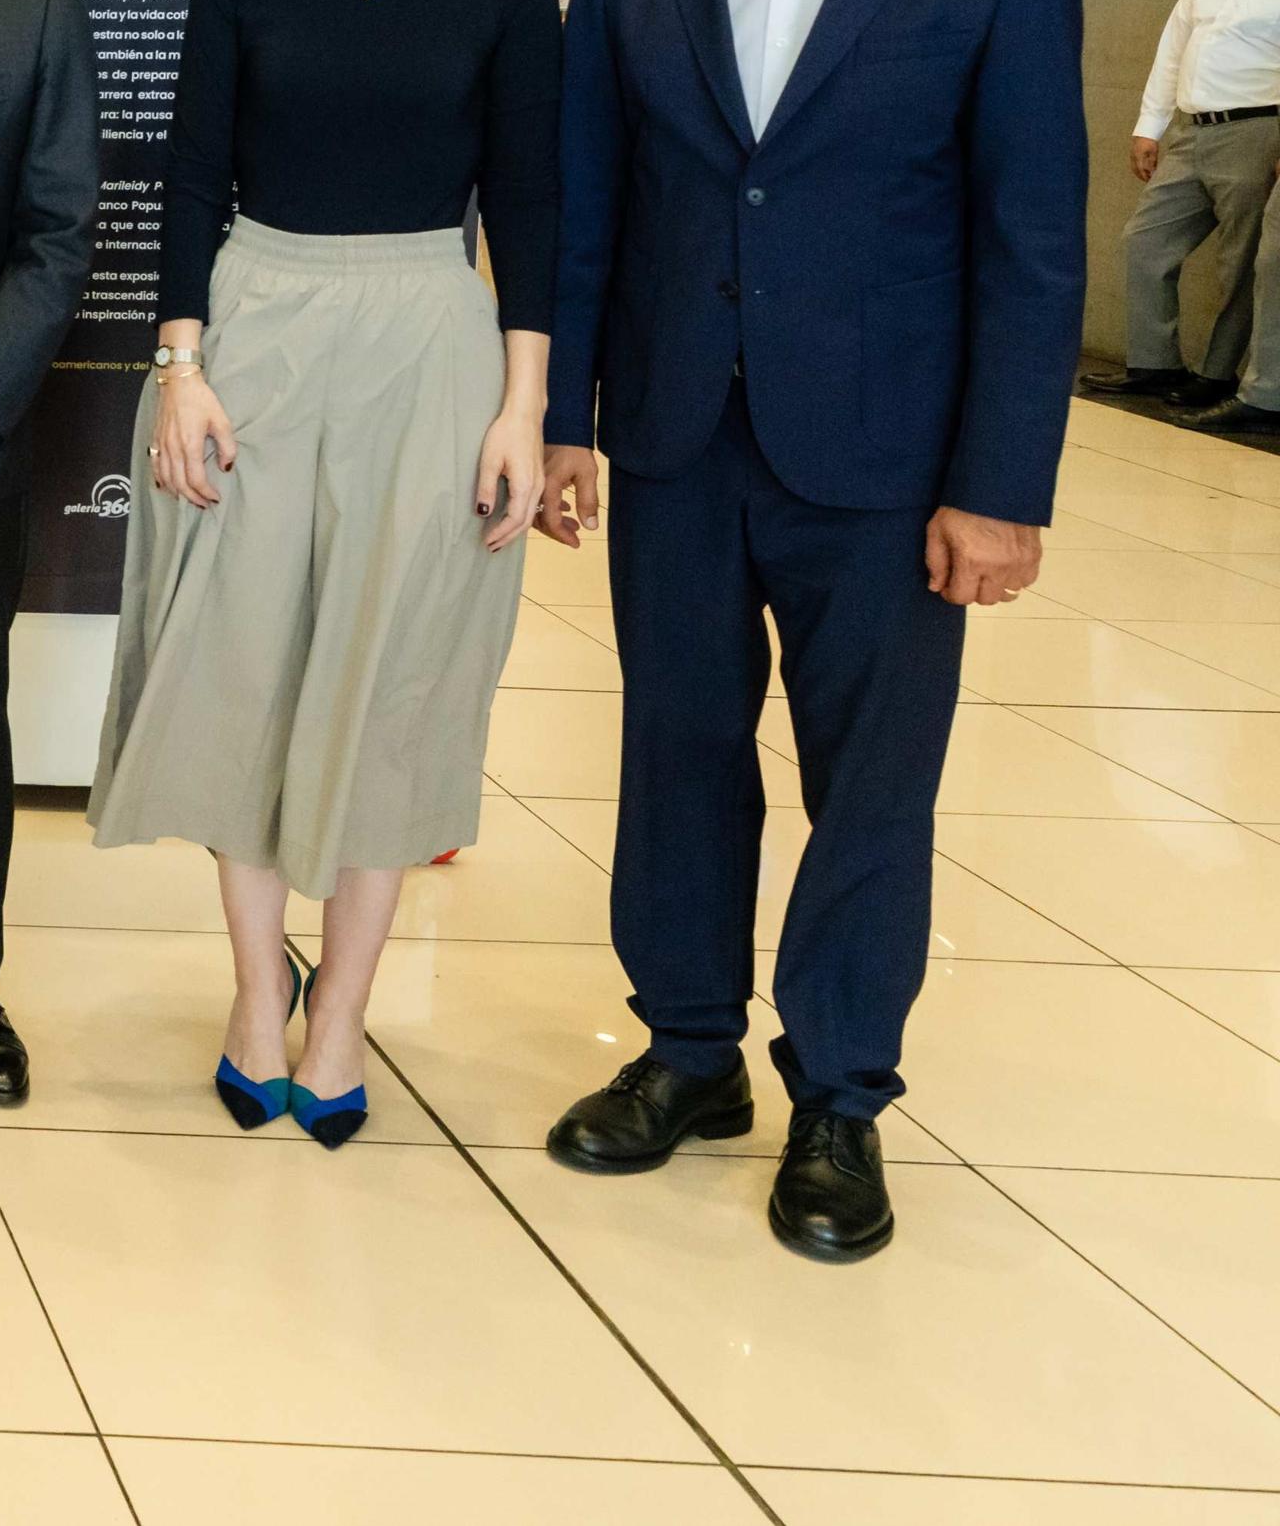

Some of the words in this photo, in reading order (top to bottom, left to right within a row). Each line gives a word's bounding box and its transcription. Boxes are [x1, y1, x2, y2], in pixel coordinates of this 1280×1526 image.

[89, 10, 117, 20] loria
[119, 12, 126, 22] y
[127, 10, 138, 20] la
[140, 10, 165, 20] vida
[124, 32, 140, 40] no
[141, 30, 165, 40] solo
[167, 32, 175, 40] a
[96, 50, 143, 60] ambién
[145, 52, 153, 60] a
[155, 50, 166, 60] la
[111, 69, 128, 80] de
[138, 90, 175, 100] extrao
[122, 109, 133, 120] la
[136, 112, 173, 122] pausa
[102, 129, 143, 140] iliencia
[146, 132, 154, 142] y
[156, 130, 167, 140] el
[98, 202, 128, 210] anco
[131, 201, 163, 213] Popu
[110, 222, 134, 232] que
[92, 271, 118, 280] esta
[82, 309, 146, 322] inspiración
[51, 360, 122, 371] oamericanos
[124, 362, 131, 372] y
[132, 360, 150, 371] del
